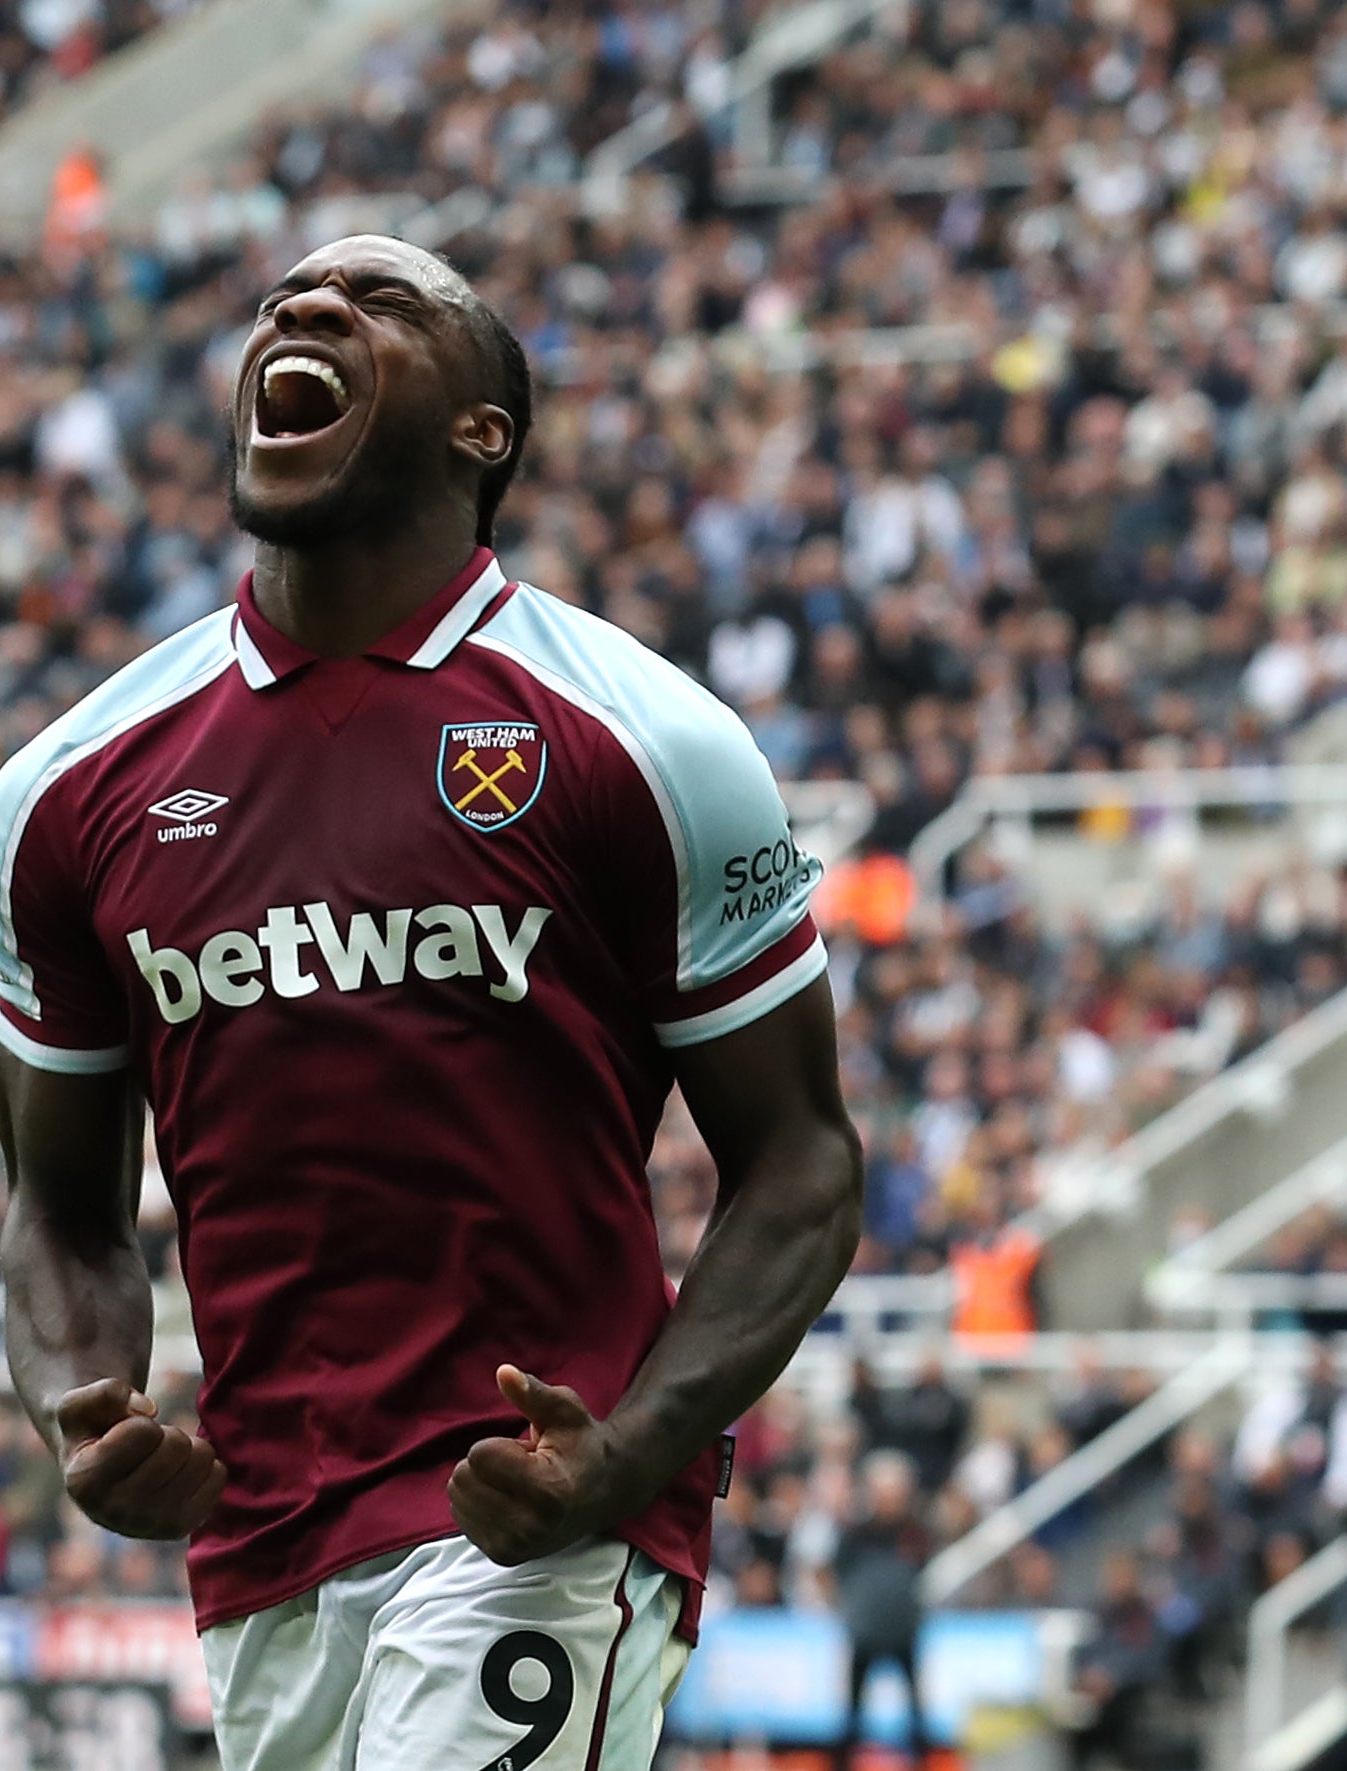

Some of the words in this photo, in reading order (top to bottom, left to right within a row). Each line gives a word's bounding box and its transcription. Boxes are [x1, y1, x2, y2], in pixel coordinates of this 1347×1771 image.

[451, 728, 495, 741] WEST
[496, 727, 535, 741] HAM
[467, 738, 518, 748] UNITED
[465, 809, 505, 822] LONDON
[157, 822, 217, 843] umbro
[127, 901, 552, 1025] betway
[478, 1628, 576, 1771] 9
